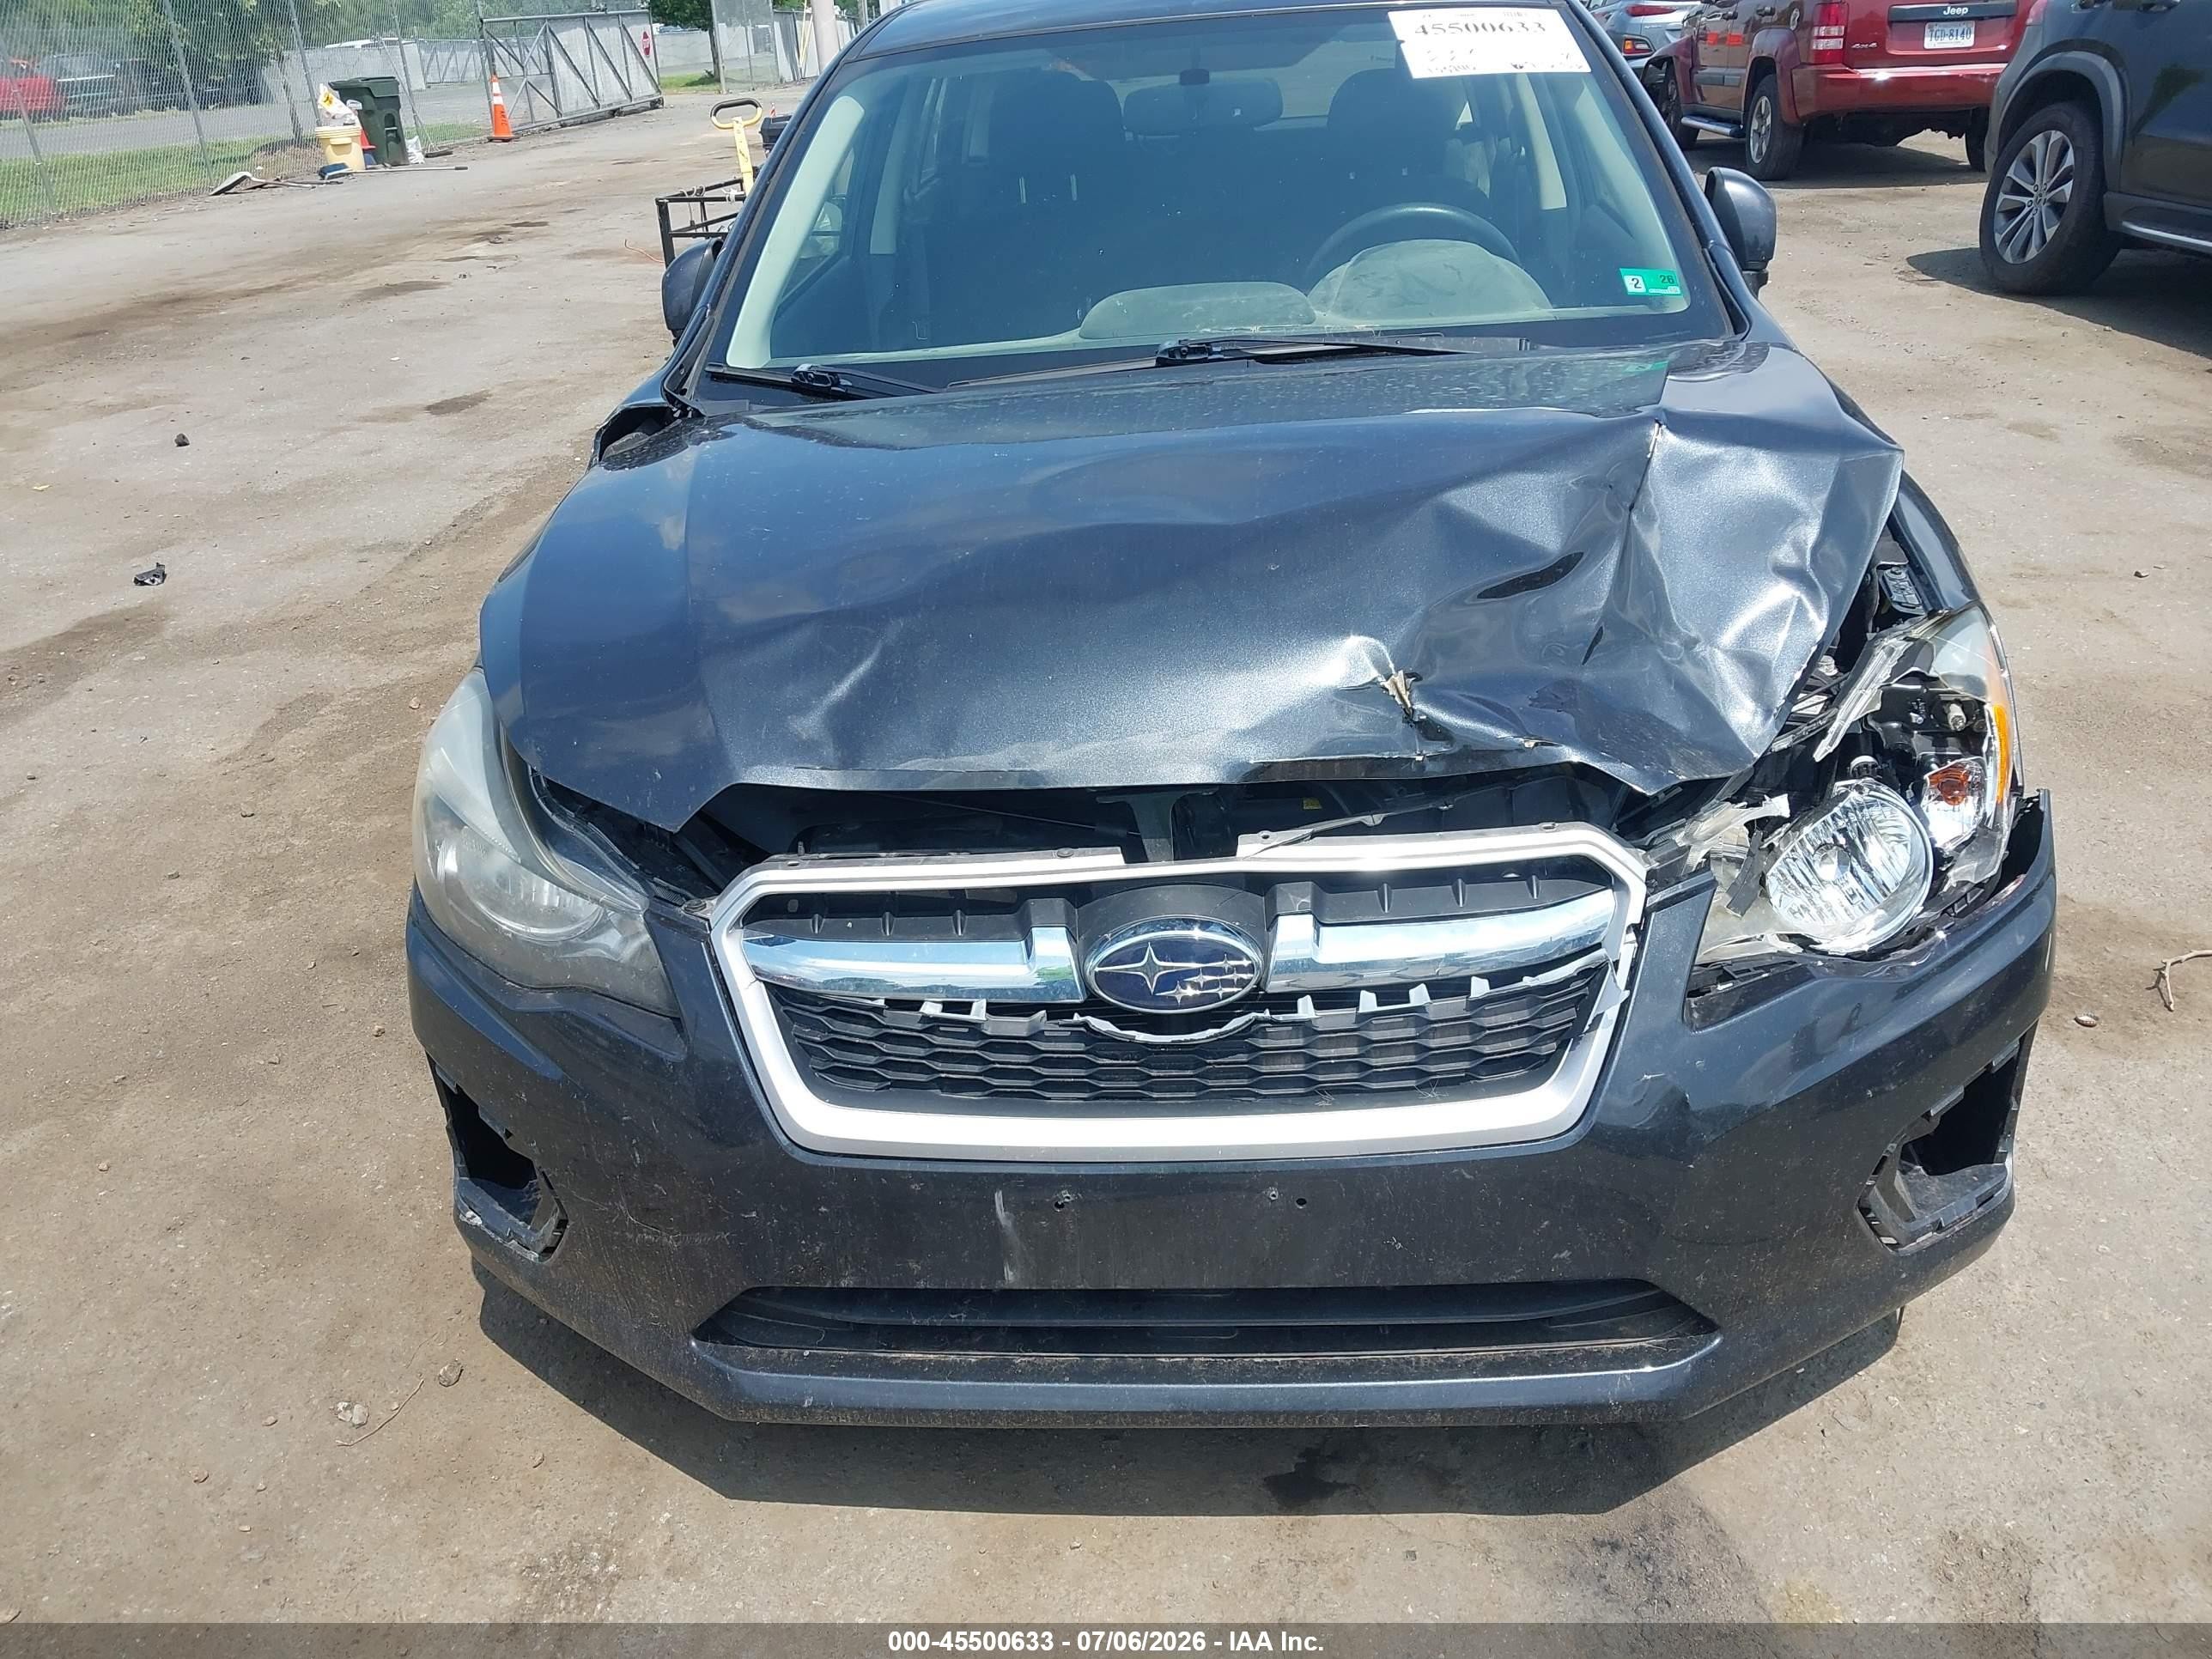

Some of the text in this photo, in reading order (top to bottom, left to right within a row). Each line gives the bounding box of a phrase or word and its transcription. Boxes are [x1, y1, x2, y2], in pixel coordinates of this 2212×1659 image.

[1943, 6, 1969, 15] Jeep
[1415, 21, 1546, 35] 45500633
[1632, 277, 1642, 289] 2
[1659, 274, 1675, 284] 26
